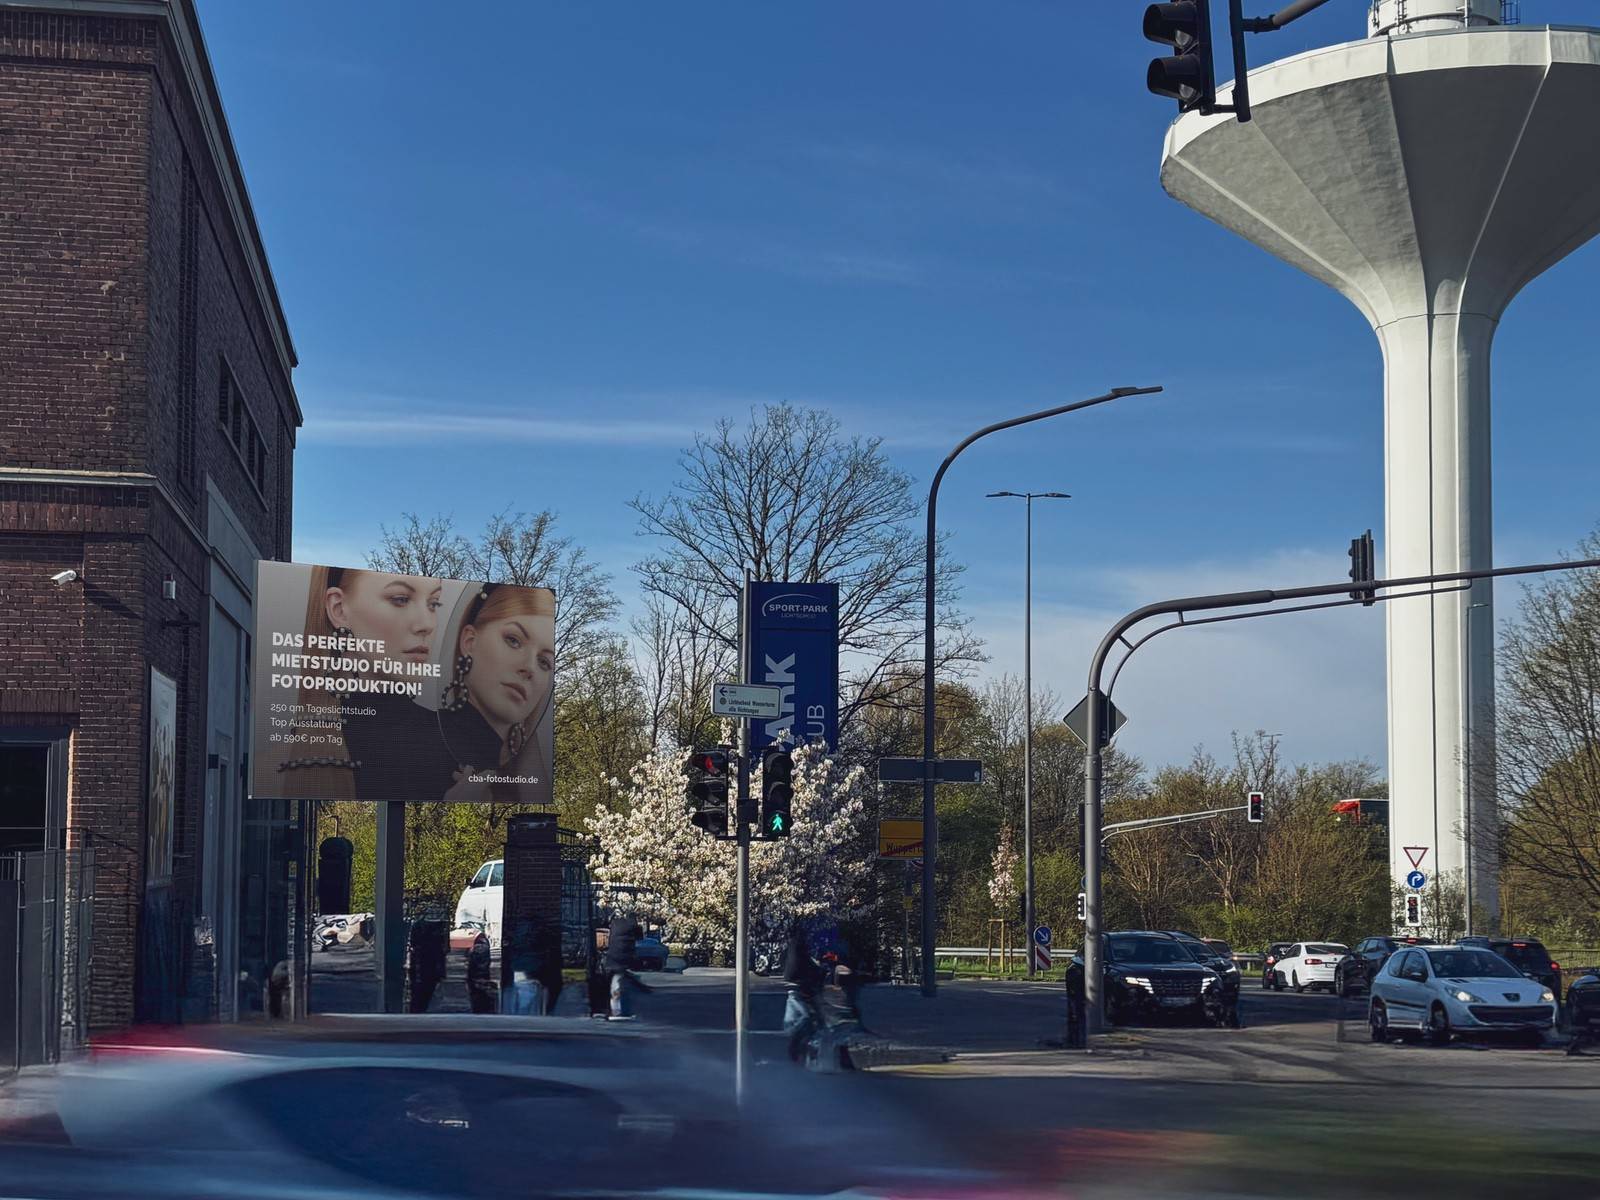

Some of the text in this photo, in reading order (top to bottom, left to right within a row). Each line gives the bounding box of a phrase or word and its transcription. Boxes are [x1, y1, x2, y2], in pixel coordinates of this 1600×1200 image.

[272, 632, 385, 653] DAS PERFEKTE
[272, 653, 441, 677] MIETSTUDIO FÜR IHRE
[271, 674, 422, 695] FOTOPRODUKTION!
[270, 703, 377, 716] 250 qm Tageslichtstudio
[270, 717, 342, 731] Top Ausstattung
[269, 732, 343, 745] ab 590€ pro Tag
[468, 773, 538, 784] cba-fotostudio.de
